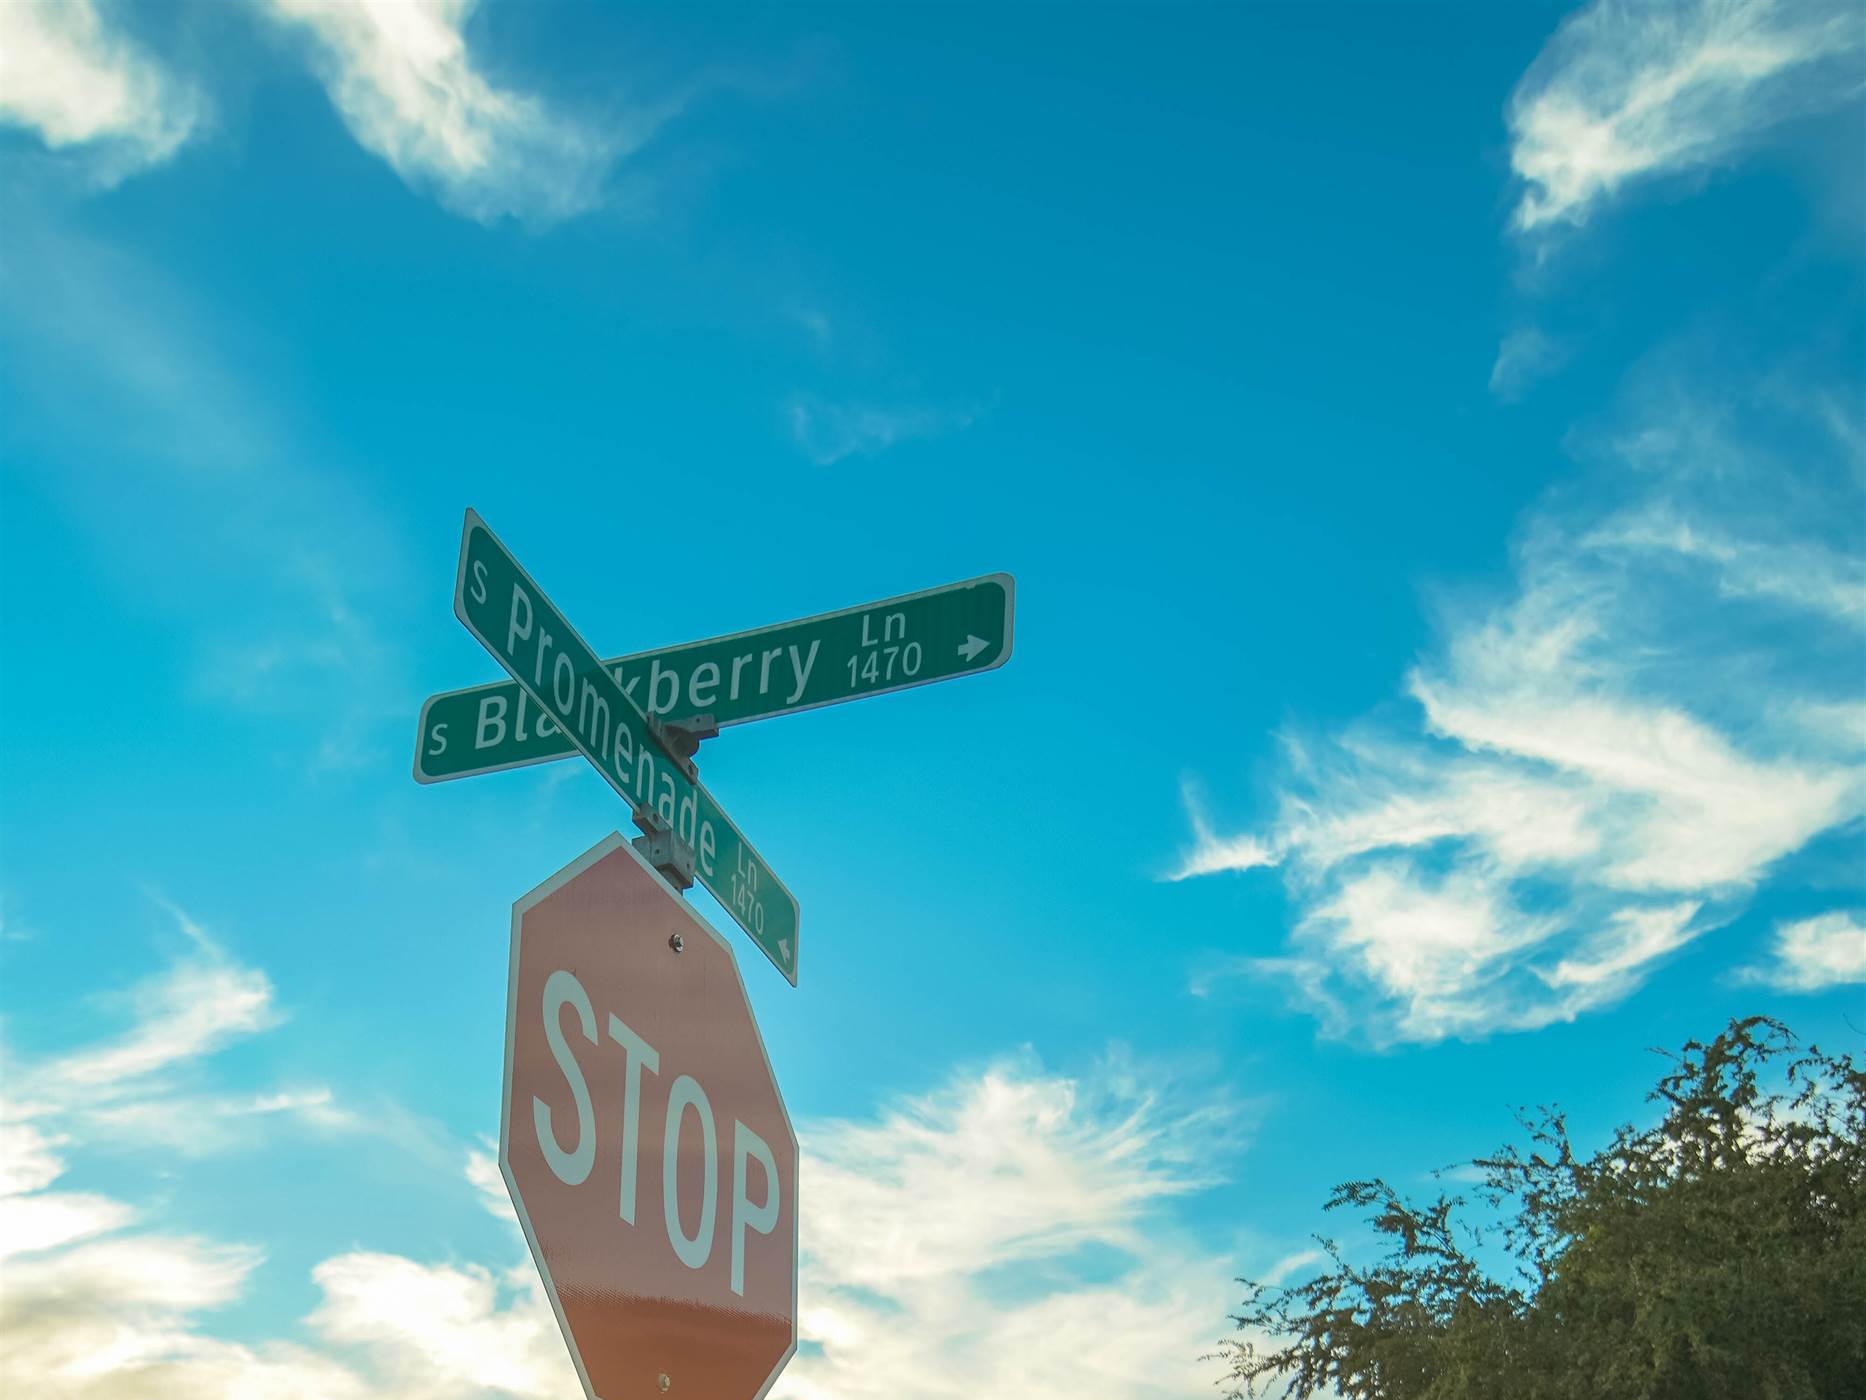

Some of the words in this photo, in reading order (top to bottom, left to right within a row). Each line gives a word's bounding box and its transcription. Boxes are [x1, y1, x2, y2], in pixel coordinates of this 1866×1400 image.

[428, 722, 449, 756] S
[475, 639, 821, 750] Blakberry
[861, 611, 906, 647] Ln
[469, 559, 489, 605] S
[507, 582, 716, 877] Promenade
[738, 842, 757, 892] Ln
[847, 642, 922, 689] 1470
[731, 874, 764, 935] 1470
[533, 970, 781, 1297] STOP
